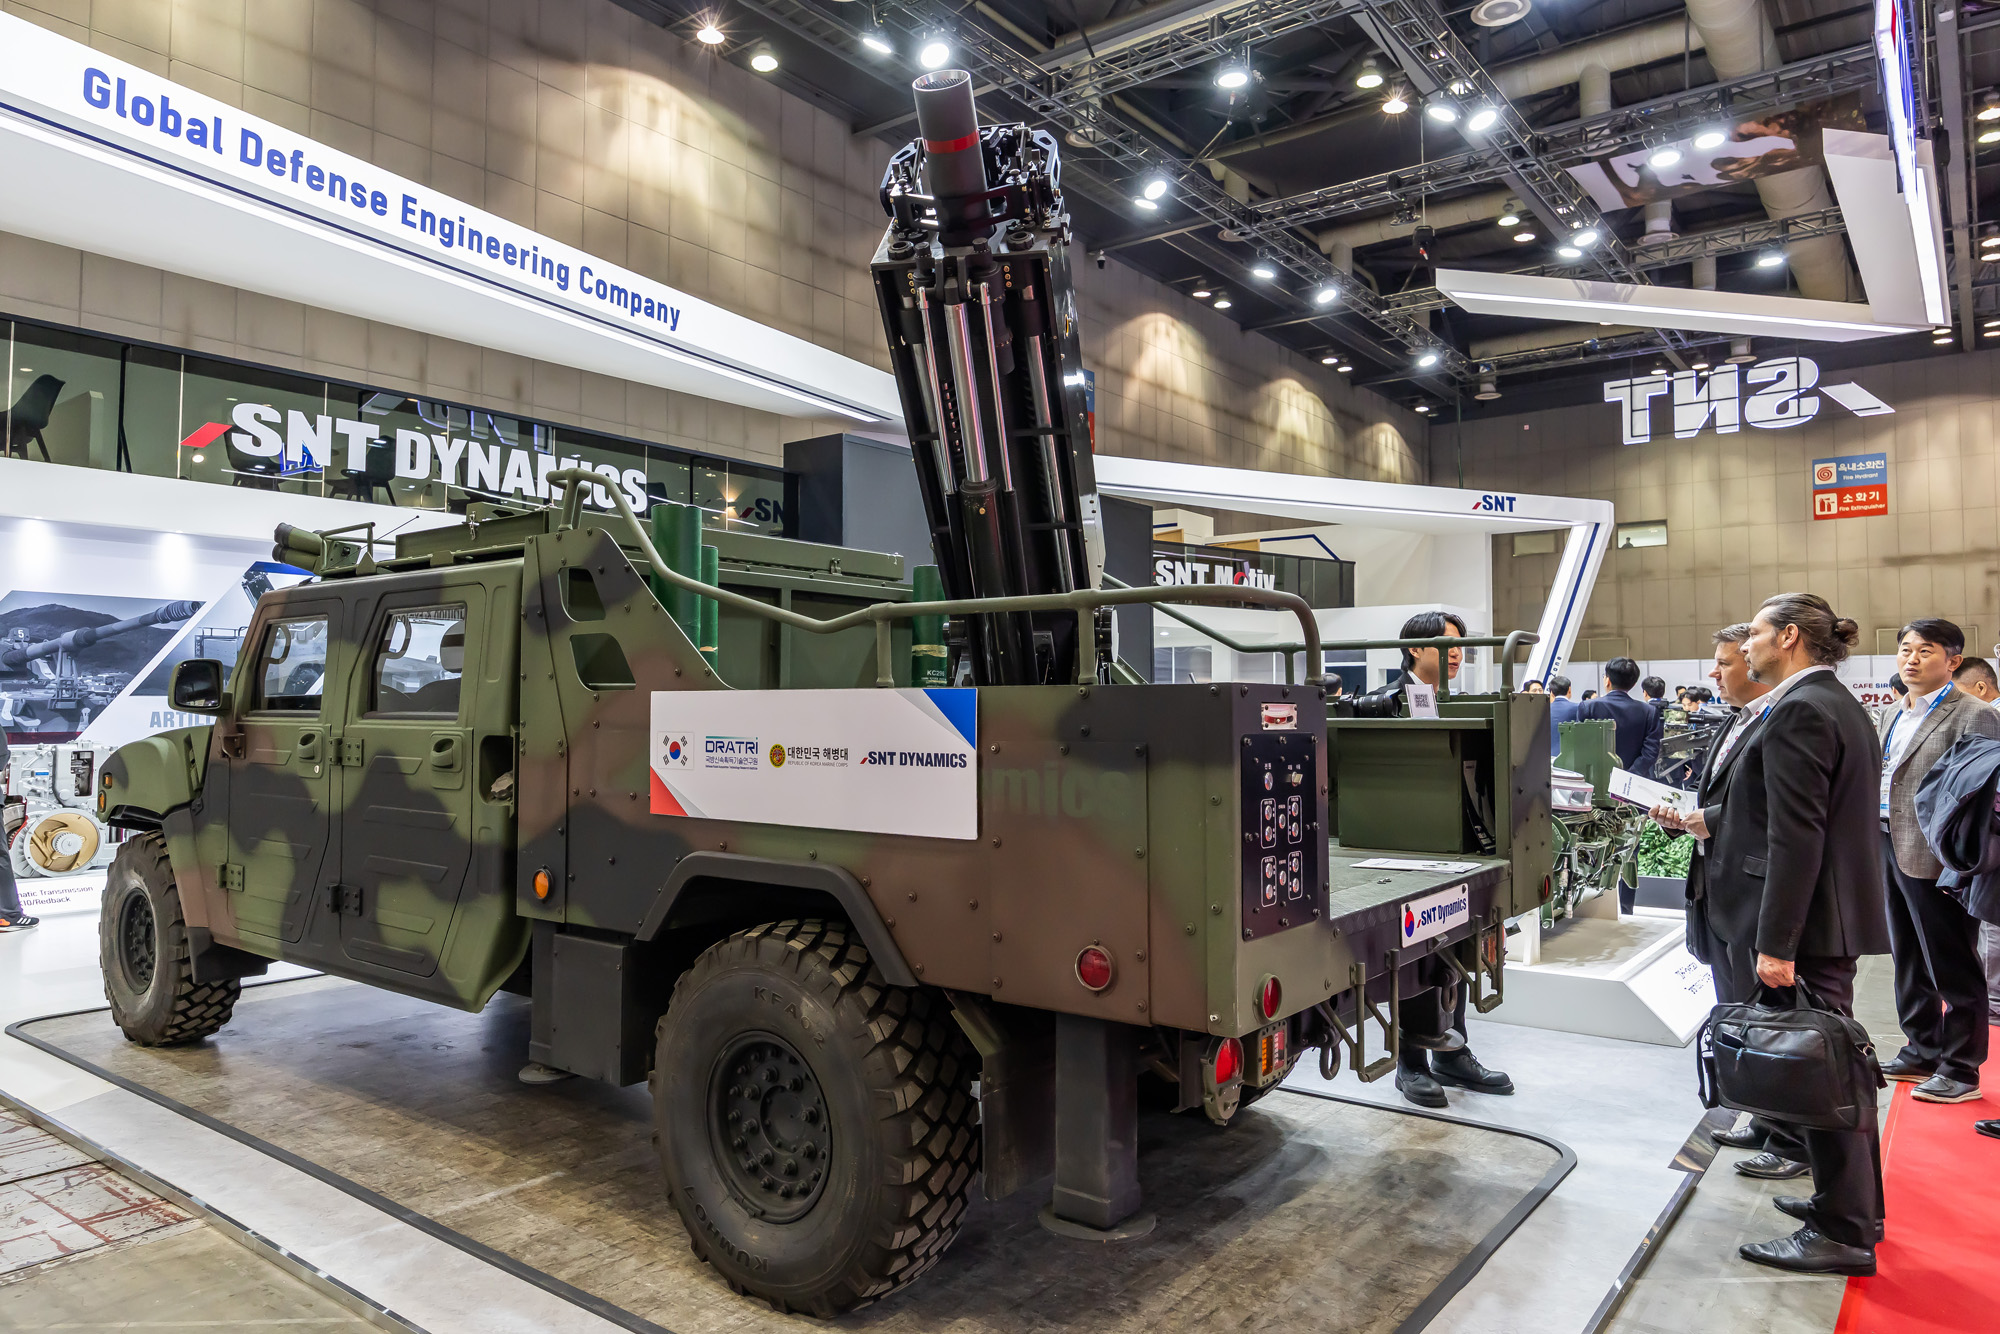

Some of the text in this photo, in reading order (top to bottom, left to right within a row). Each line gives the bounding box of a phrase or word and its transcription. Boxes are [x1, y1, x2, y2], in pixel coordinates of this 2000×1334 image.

[83, 67, 681, 332] Global Defense Engineering Company
[231, 402, 380, 472] SNT
[396, 428, 648, 513] DYNAMICS
[1838, 459, 1885, 472] 옥내소화전
[1482, 494, 1517, 512] SNT
[1842, 491, 1880, 503] 소화기
[1850, 503, 1886, 511] Extinguisher
[1155, 560, 1210, 586] SNT
[18, 629, 24, 638] 5
[787, 746, 820, 760] 대한민국
[822, 747, 849, 761] 해병대
[868, 751, 967, 768] SNT DYNAMICS
[39, 886, 93, 896] Transmission
[1421, 897, 1467, 926] SNT Dynamics
